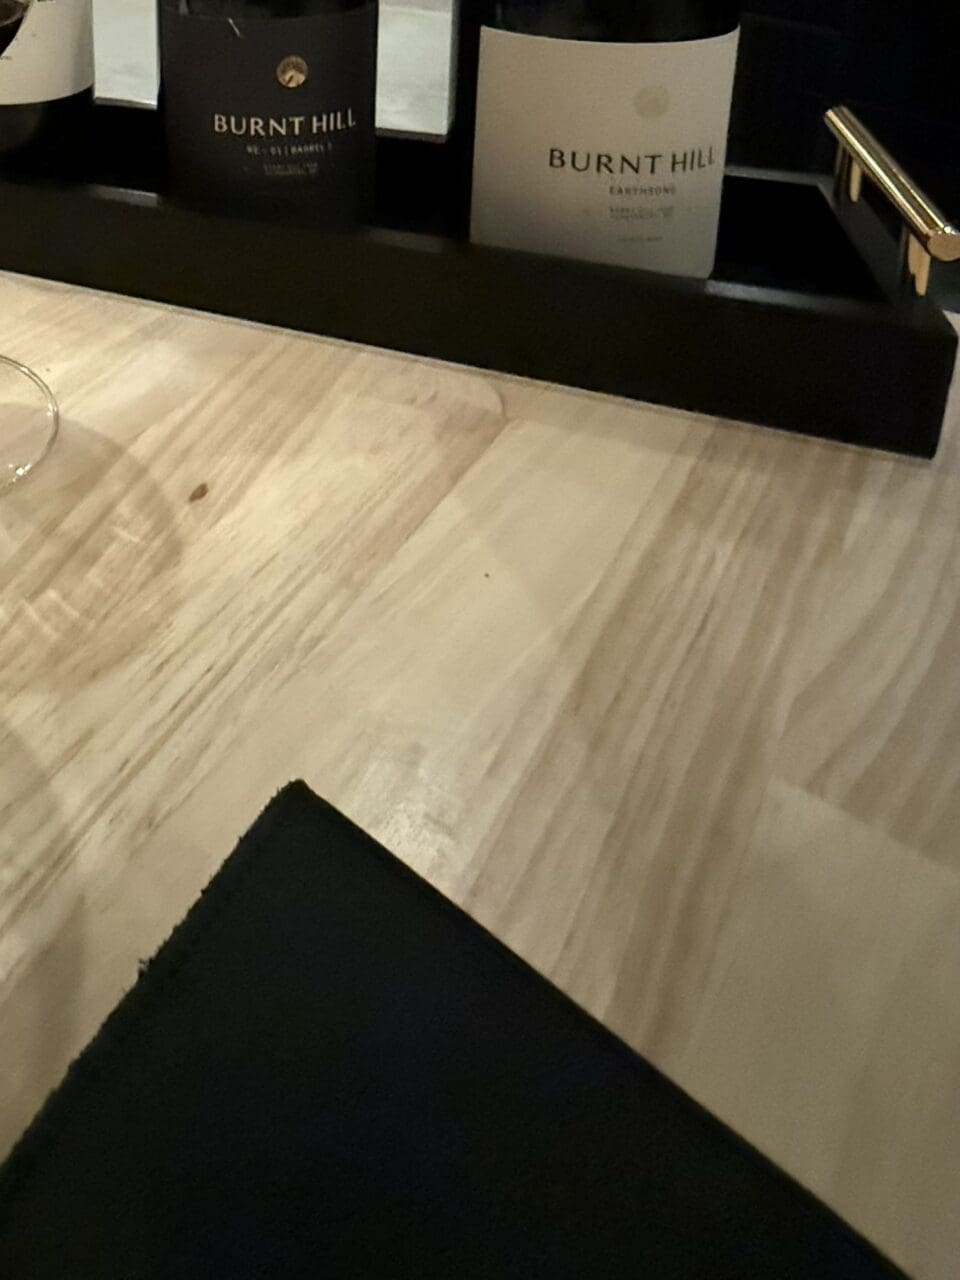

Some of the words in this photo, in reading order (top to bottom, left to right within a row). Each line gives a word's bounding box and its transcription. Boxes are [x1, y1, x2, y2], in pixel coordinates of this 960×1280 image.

[214, 113, 305, 136] BURNT
[312, 107, 356, 134] HILL
[549, 148, 663, 174] BURNT
[671, 145, 715, 172] HILL
